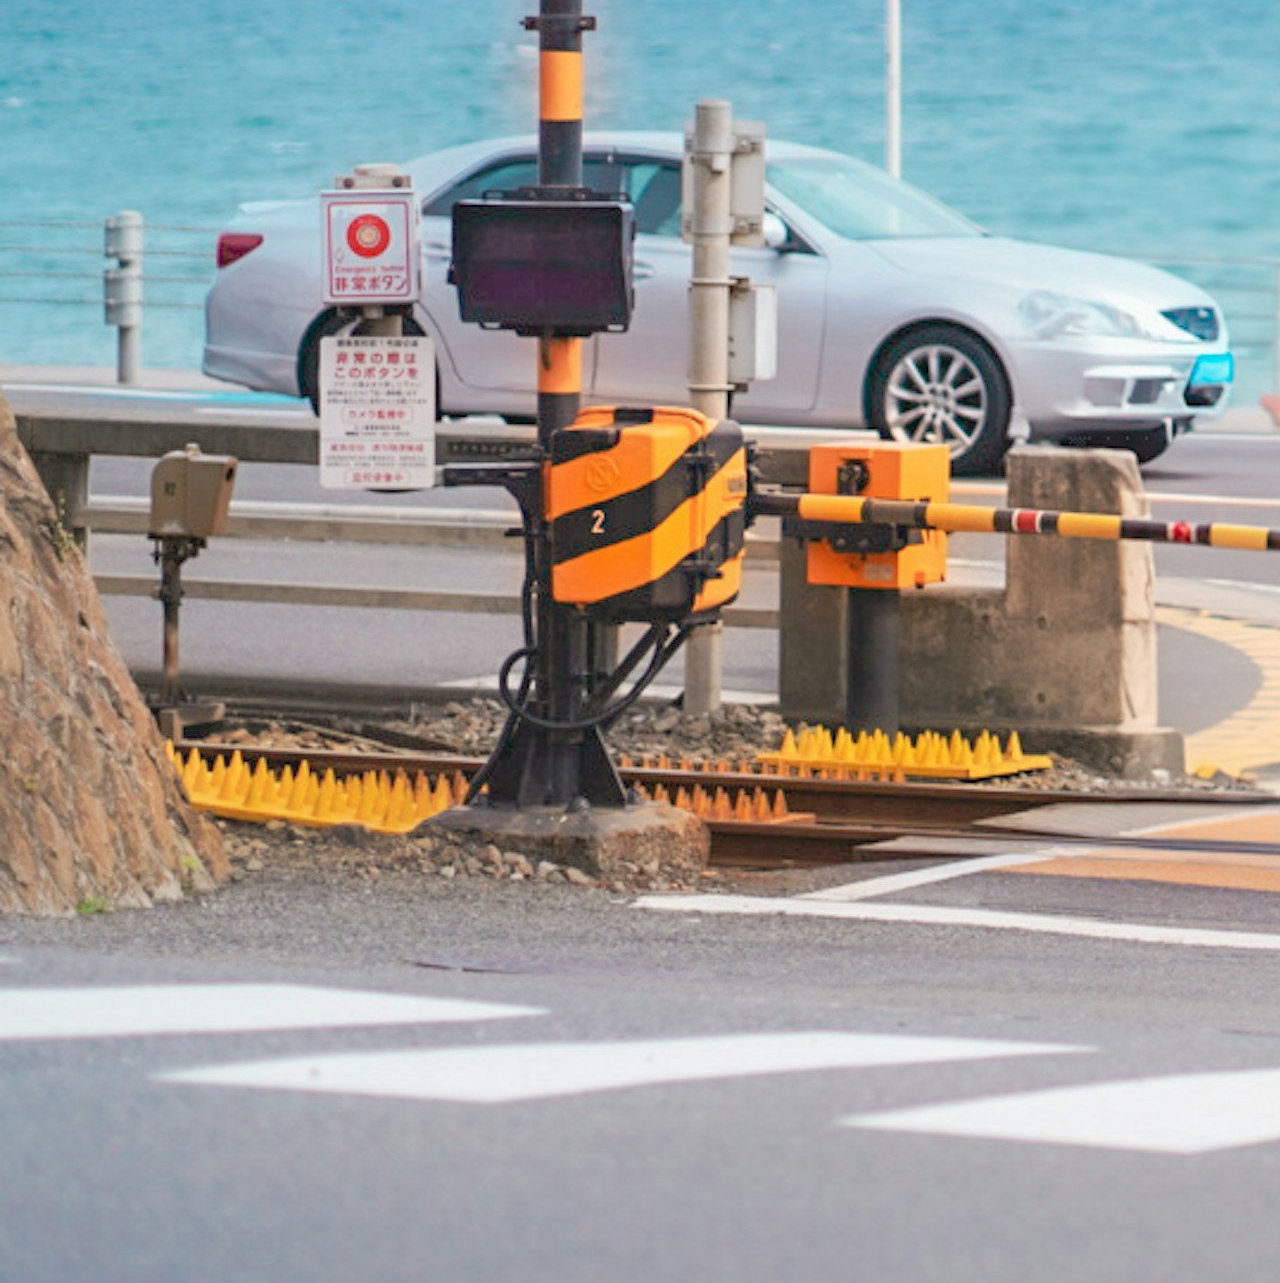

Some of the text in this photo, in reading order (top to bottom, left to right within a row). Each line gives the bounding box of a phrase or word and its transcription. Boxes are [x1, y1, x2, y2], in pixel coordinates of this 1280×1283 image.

[335, 274, 407, 292] 非常ボタン
[334, 367, 419, 379] このボタンを
[591, 509, 606, 534] 2
